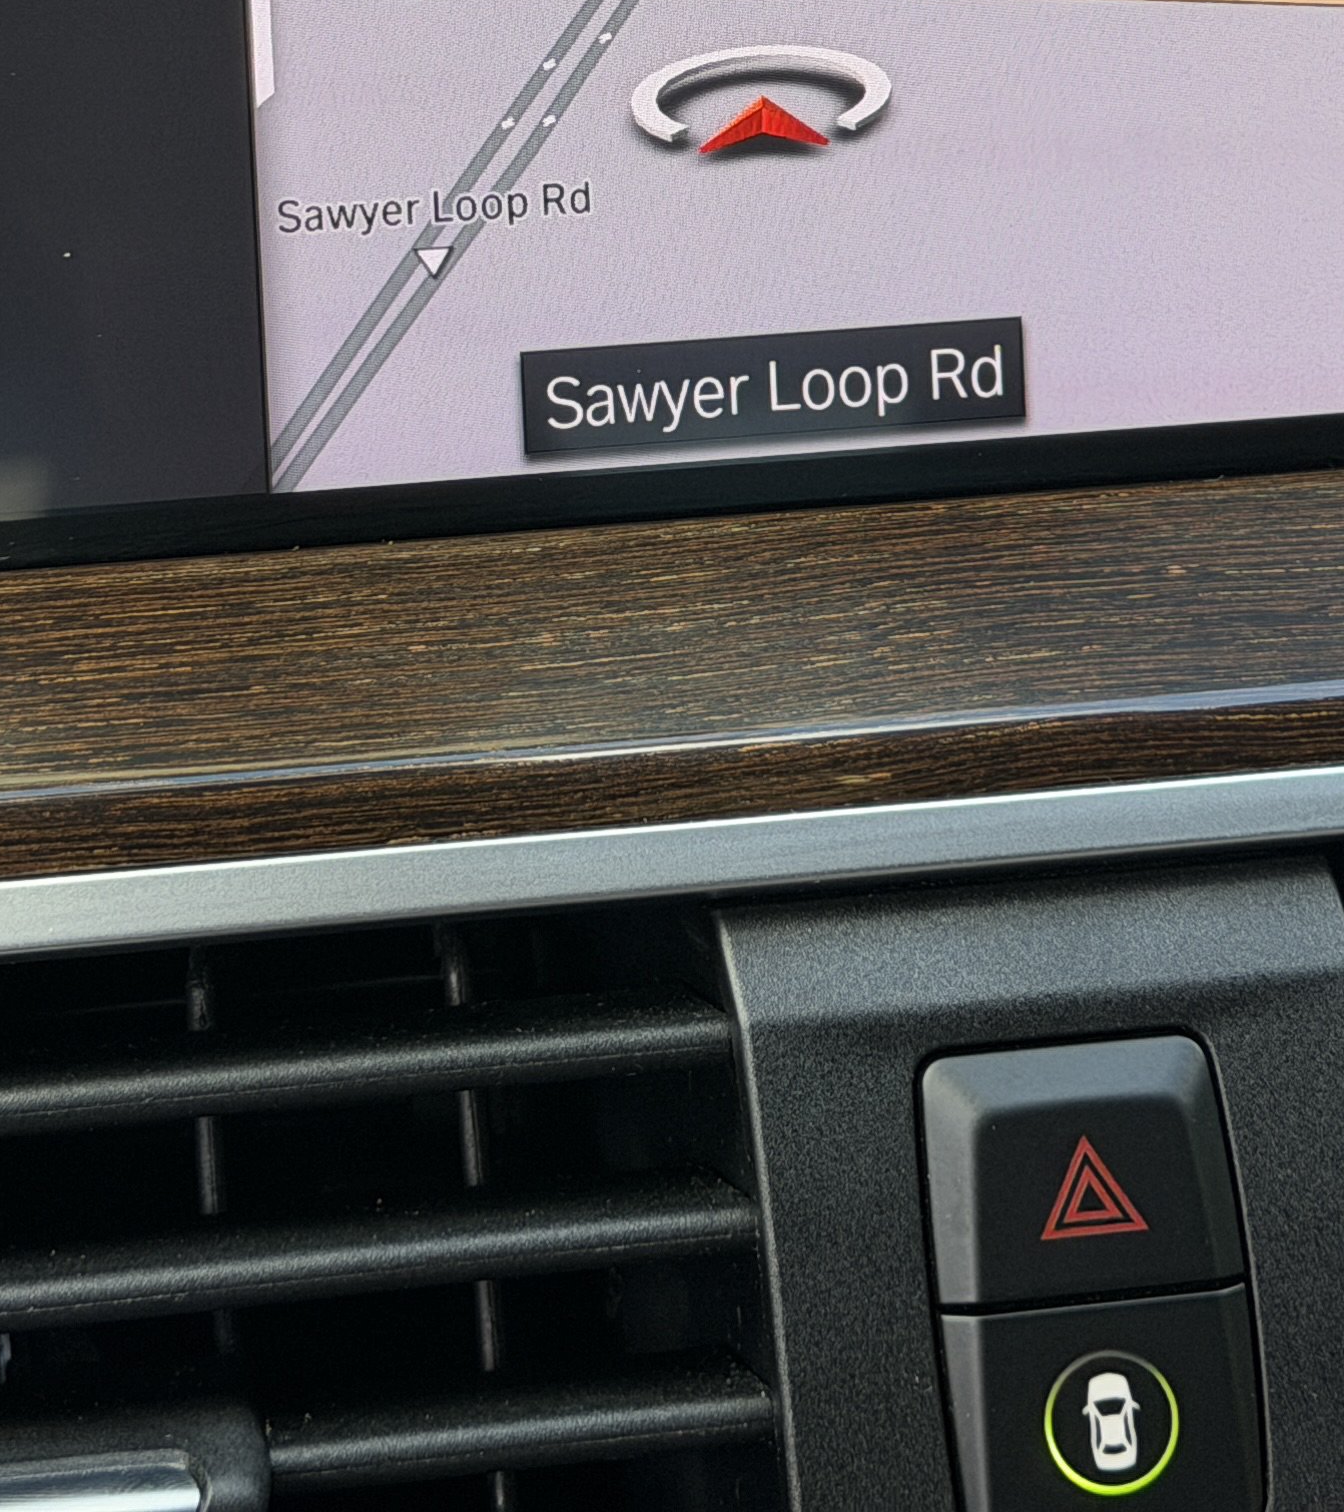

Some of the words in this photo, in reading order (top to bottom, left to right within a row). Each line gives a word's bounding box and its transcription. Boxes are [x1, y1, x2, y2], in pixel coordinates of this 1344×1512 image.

[277, 194, 419, 234] Sawyer
[432, 189, 530, 223] Loop
[542, 181, 592, 215] Rd
[547, 375, 749, 432] Sawyer
[769, 361, 908, 416] Loop
[931, 345, 1003, 400] Rd
